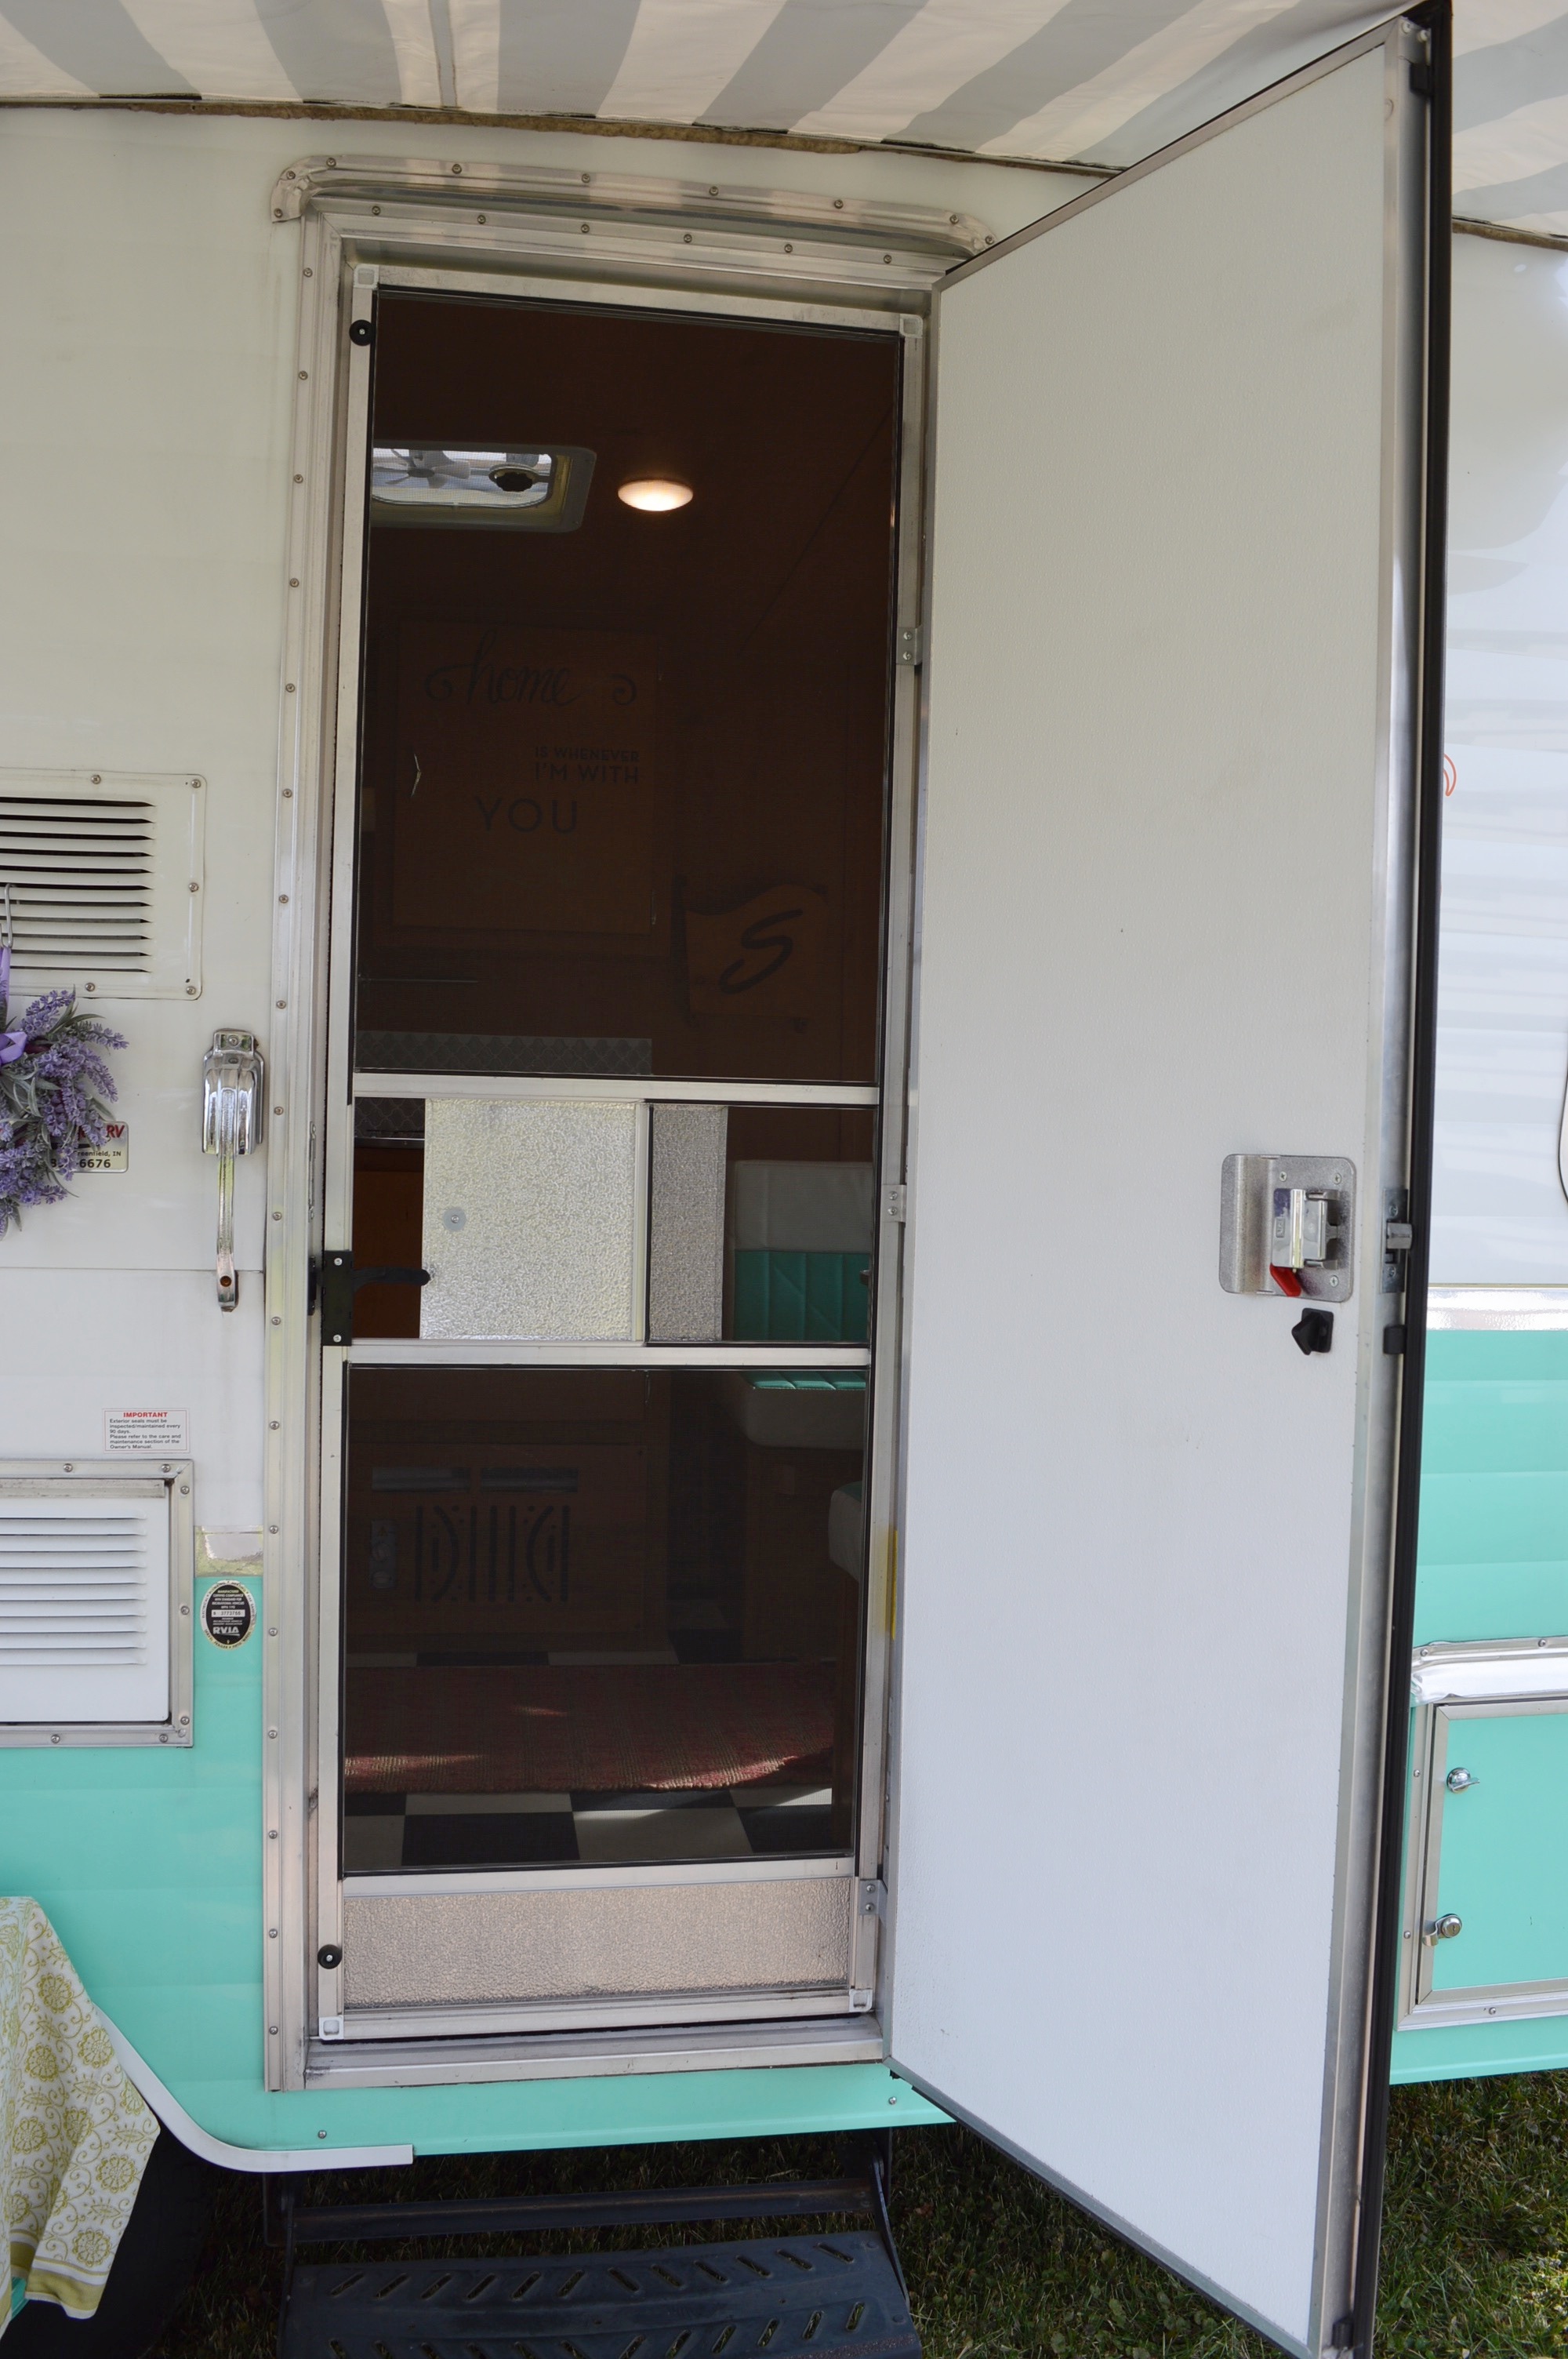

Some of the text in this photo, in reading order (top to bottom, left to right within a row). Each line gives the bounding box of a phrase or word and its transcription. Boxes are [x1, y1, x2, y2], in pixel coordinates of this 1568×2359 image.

[426, 629, 581, 706] home
[535, 746, 640, 763] IS WHENEVER
[535, 764, 640, 784] I'M WITH
[474, 794, 579, 834] YOU
[107, 1125, 125, 1138] RV
